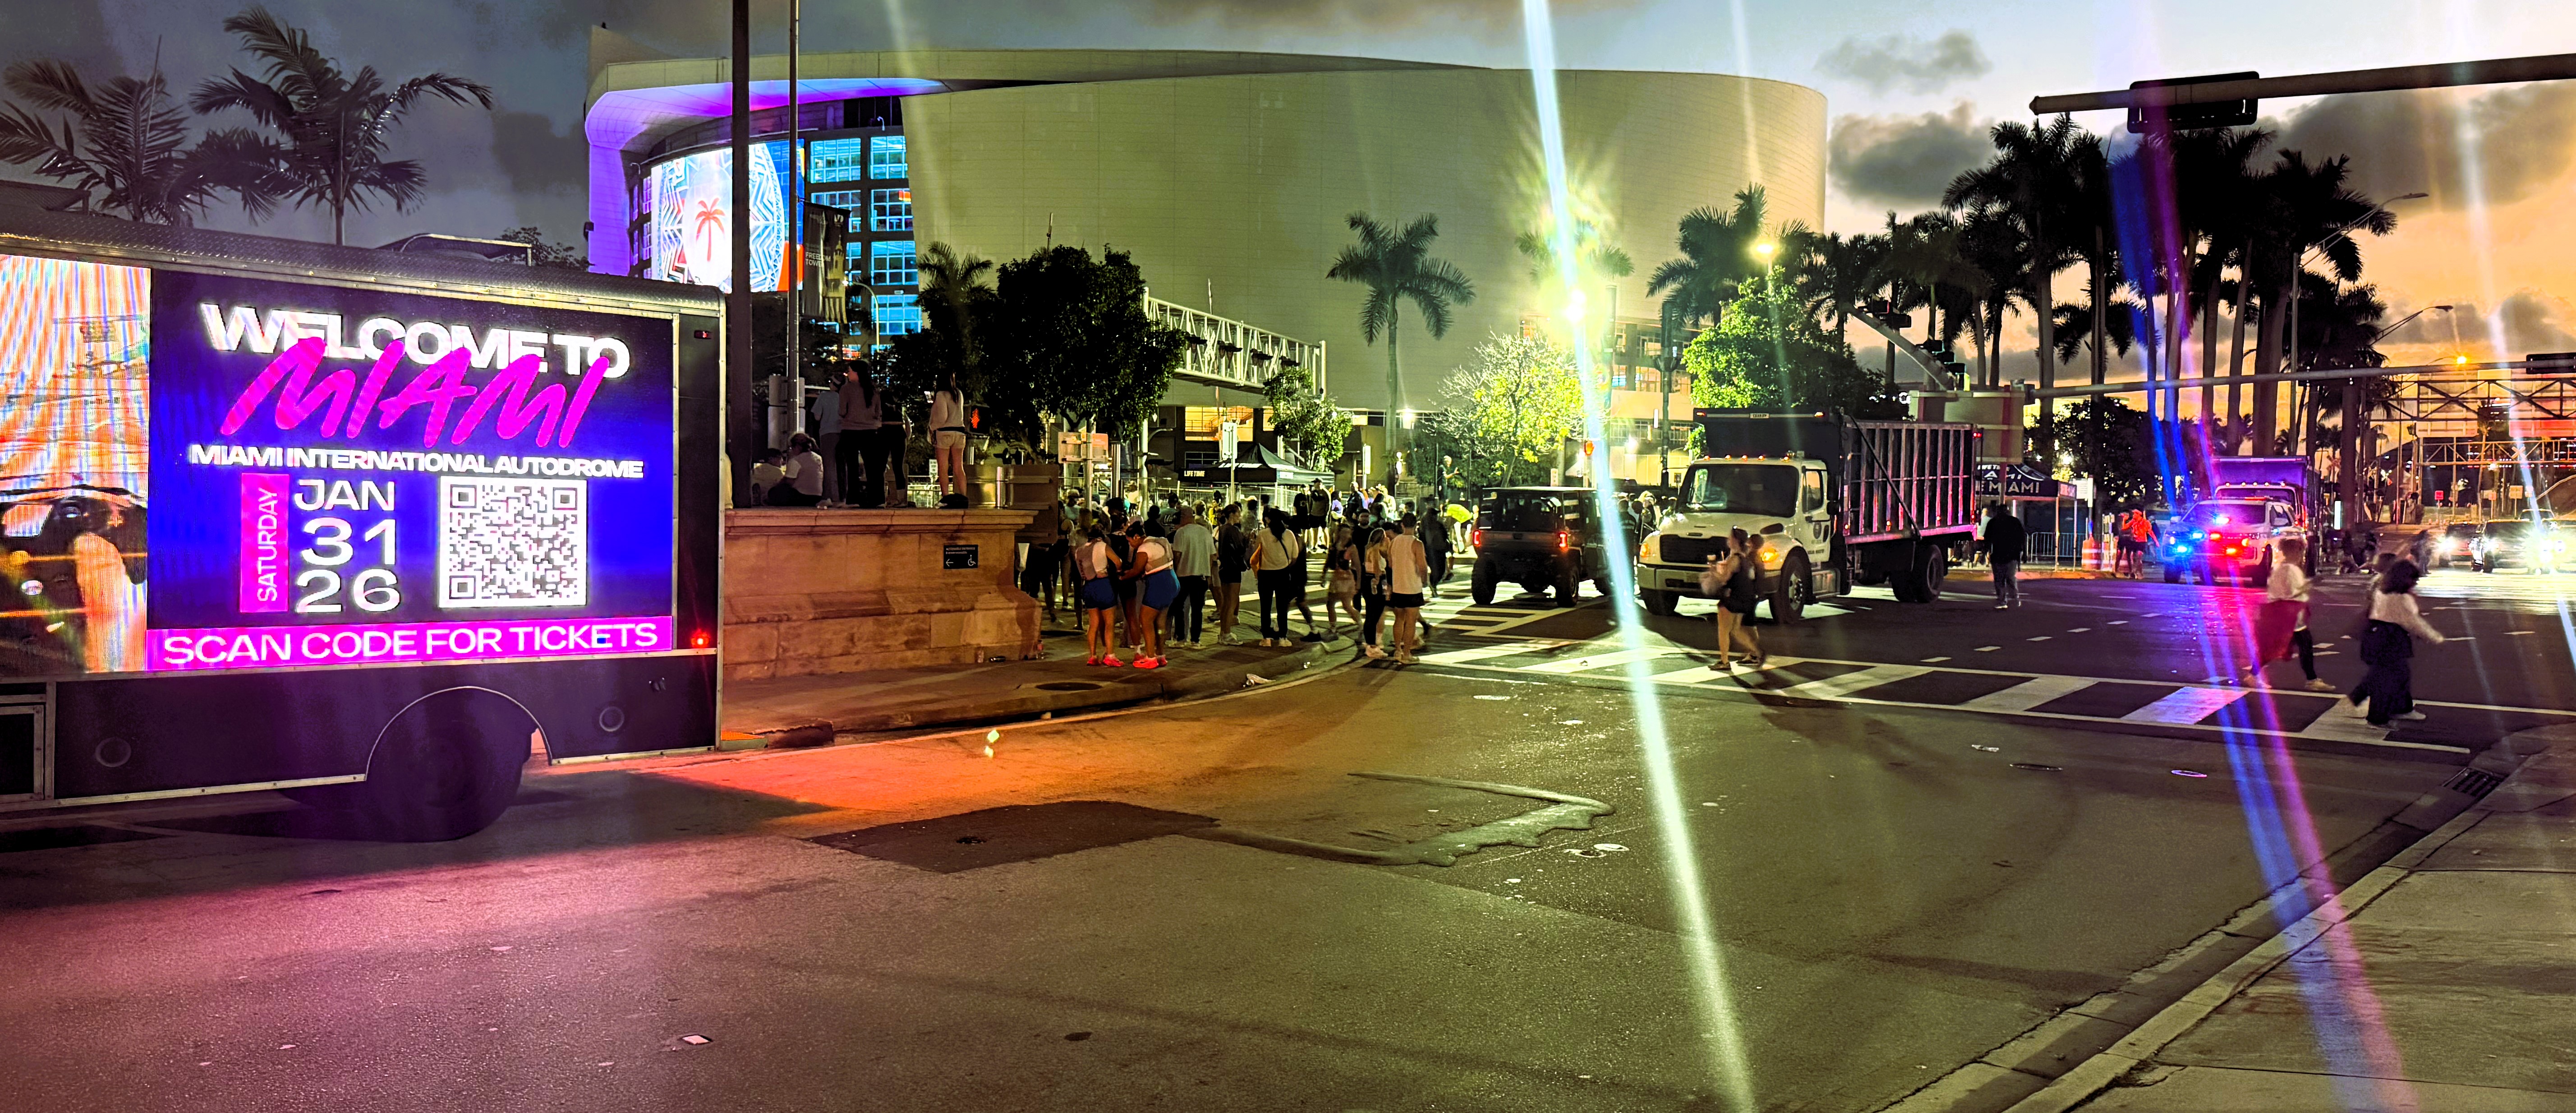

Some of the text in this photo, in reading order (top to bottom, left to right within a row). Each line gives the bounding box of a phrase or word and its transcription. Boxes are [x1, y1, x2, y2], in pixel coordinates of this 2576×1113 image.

[805, 258, 824, 267] TOWE
[201, 304, 630, 378] WELCOME TO
[220, 336, 610, 449] MIAMI
[191, 444, 644, 478] MIAMI INTERNATIONAL AUTODROME
[294, 479, 395, 511] JAN
[1989, 481, 2039, 493] MAMI
[257, 488, 278, 602] SATURDAY
[301, 517, 396, 566] 31
[296, 569, 400, 613] 26
[163, 622, 658, 664] SCAN CODE FOR TICKETS
